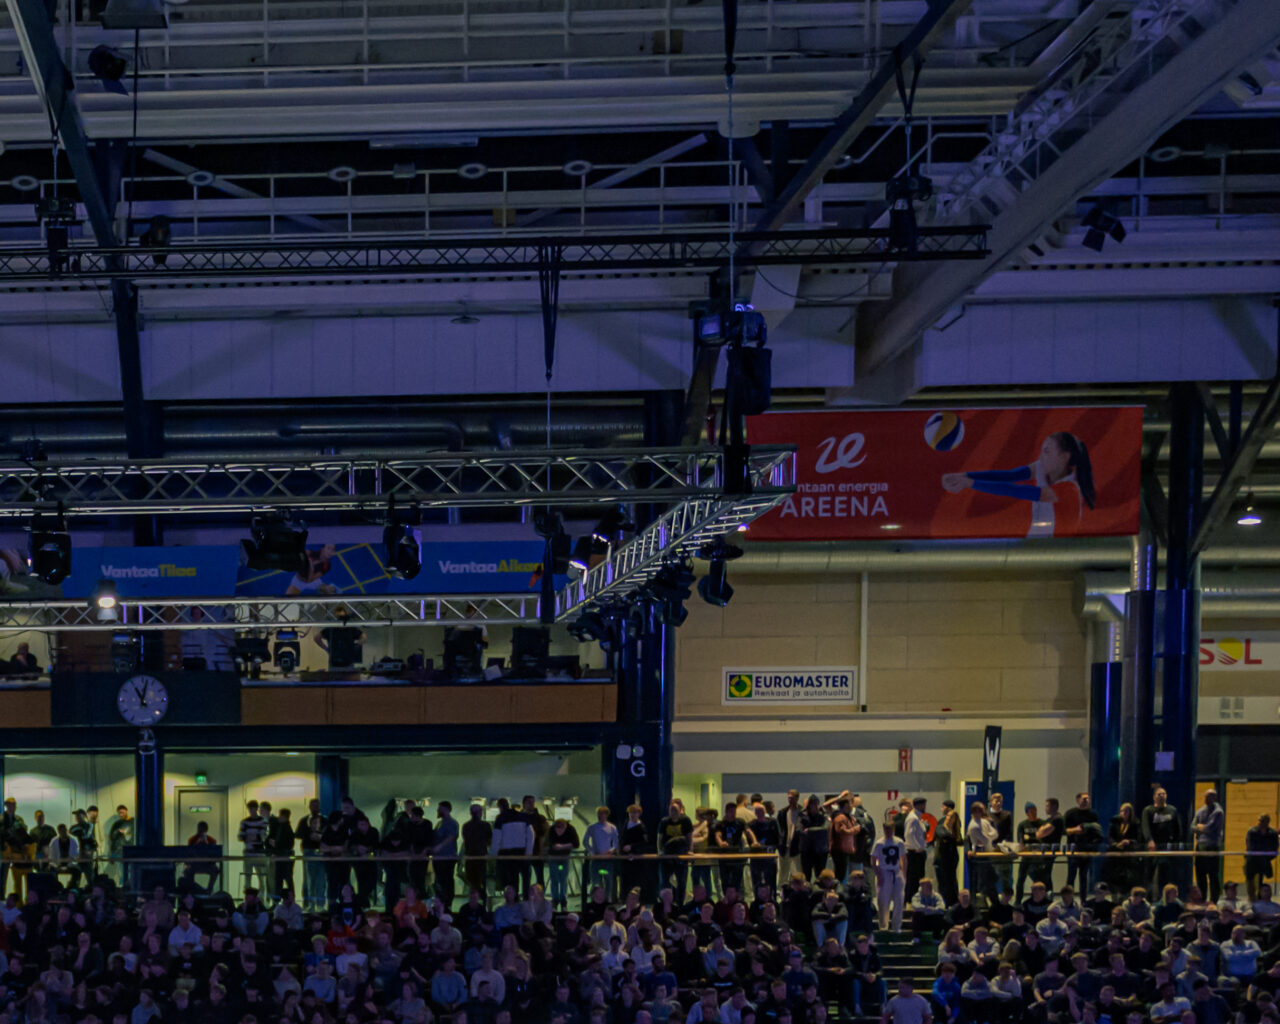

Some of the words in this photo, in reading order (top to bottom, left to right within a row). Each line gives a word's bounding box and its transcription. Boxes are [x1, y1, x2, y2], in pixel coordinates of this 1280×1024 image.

[797, 482, 835, 493] ntaan
[838, 482, 889, 494] energia
[780, 495, 889, 518] AREENA
[754, 675, 849, 688] EUROMASTER
[630, 760, 646, 777] G
